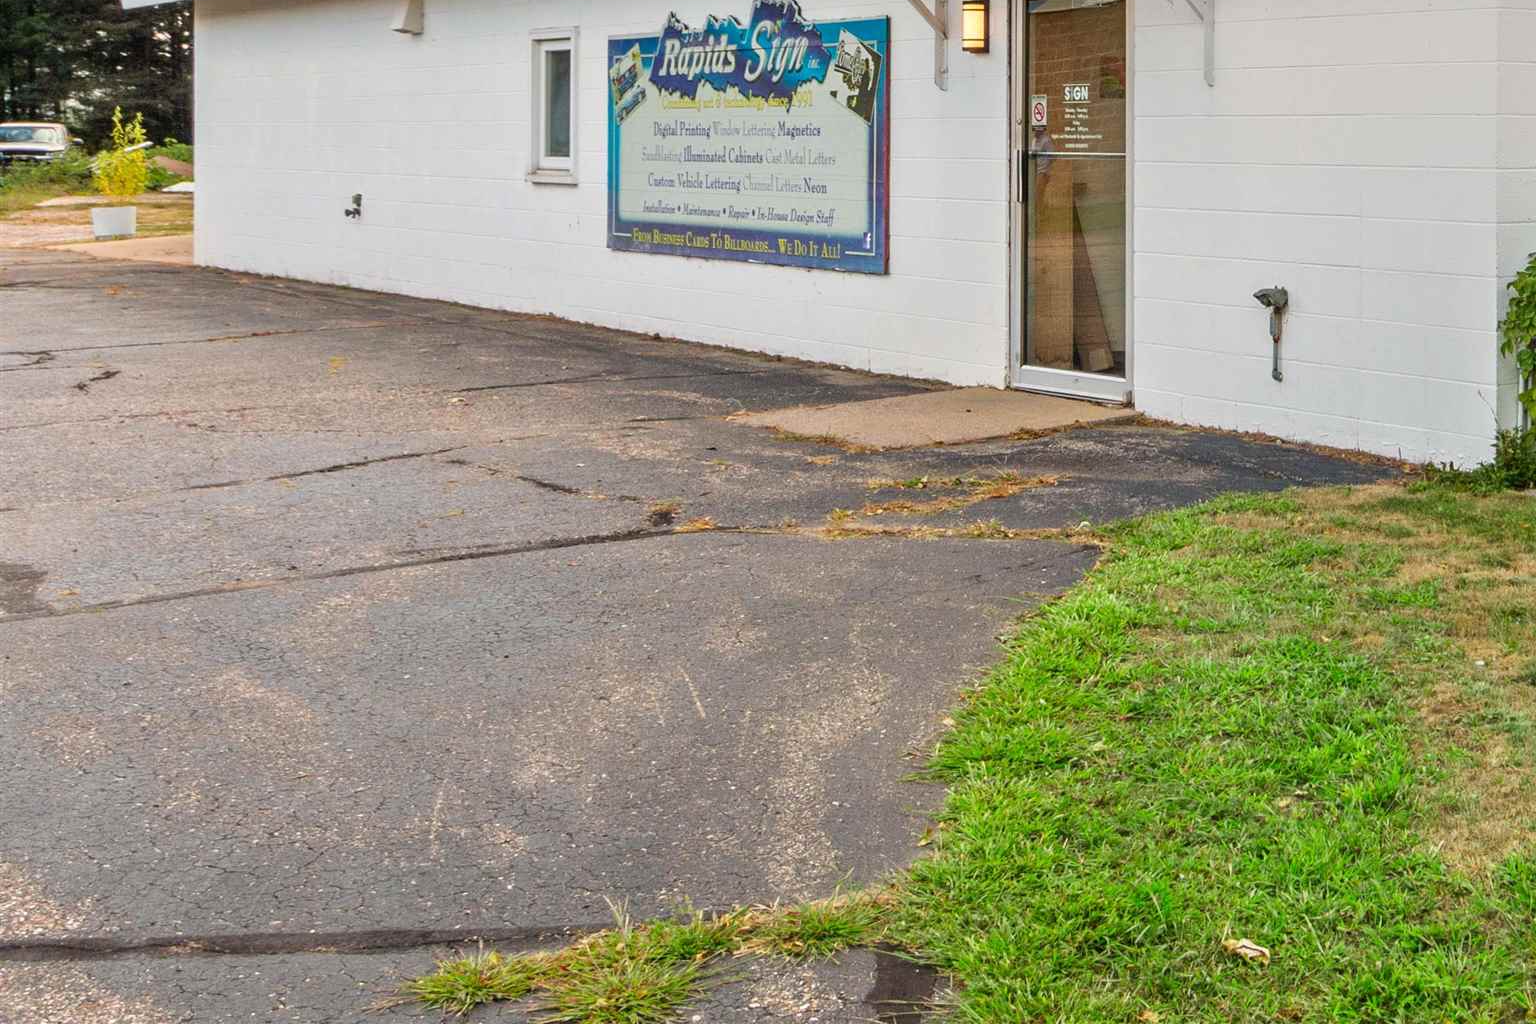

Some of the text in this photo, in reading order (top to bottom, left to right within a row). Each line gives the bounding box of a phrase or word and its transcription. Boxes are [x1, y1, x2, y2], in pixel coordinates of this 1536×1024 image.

[658, 35, 737, 80] Rapids
[743, 20, 809, 82] Sign
[1064, 86, 1088, 101] SIGN
[653, 120, 678, 139] Digital
[679, 120, 711, 140] Printing
[777, 121, 821, 140] Magnetics
[683, 144, 727, 163] Illuminated
[728, 144, 763, 164] Cabinets
[677, 171, 703, 188] Vehicle
[705, 174, 741, 194] Lettering
[803, 177, 827, 194] Neon
[816, 208, 836, 227] Staff
